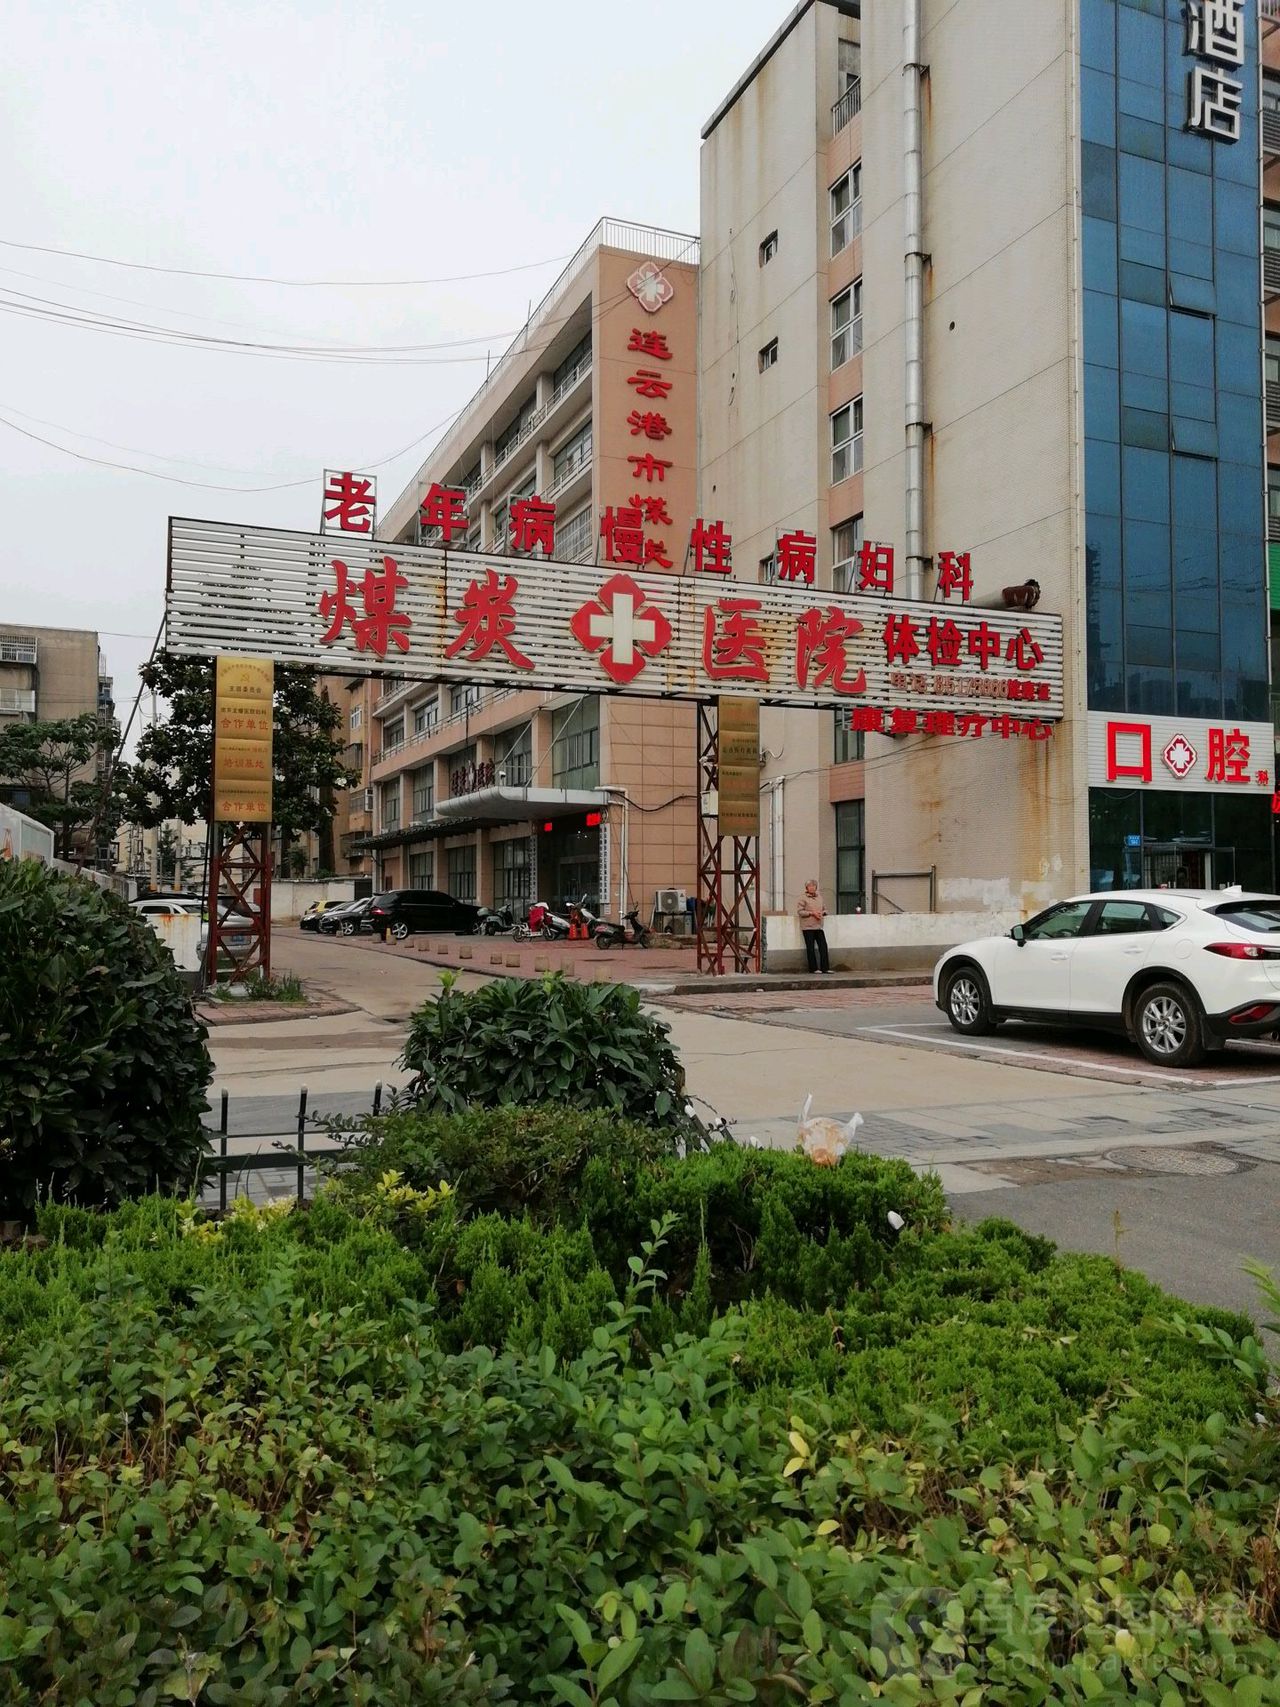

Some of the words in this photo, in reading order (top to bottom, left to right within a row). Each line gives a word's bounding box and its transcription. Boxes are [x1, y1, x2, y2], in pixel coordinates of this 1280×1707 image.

[1189, 0, 1245, 140] 酒店
[882, 614, 1045, 670] 体检中心
[220, 717, 269, 730] 合作单位
[851, 705, 1053, 742] 康复理疗中心
[222, 800, 267, 813] 合作单位
